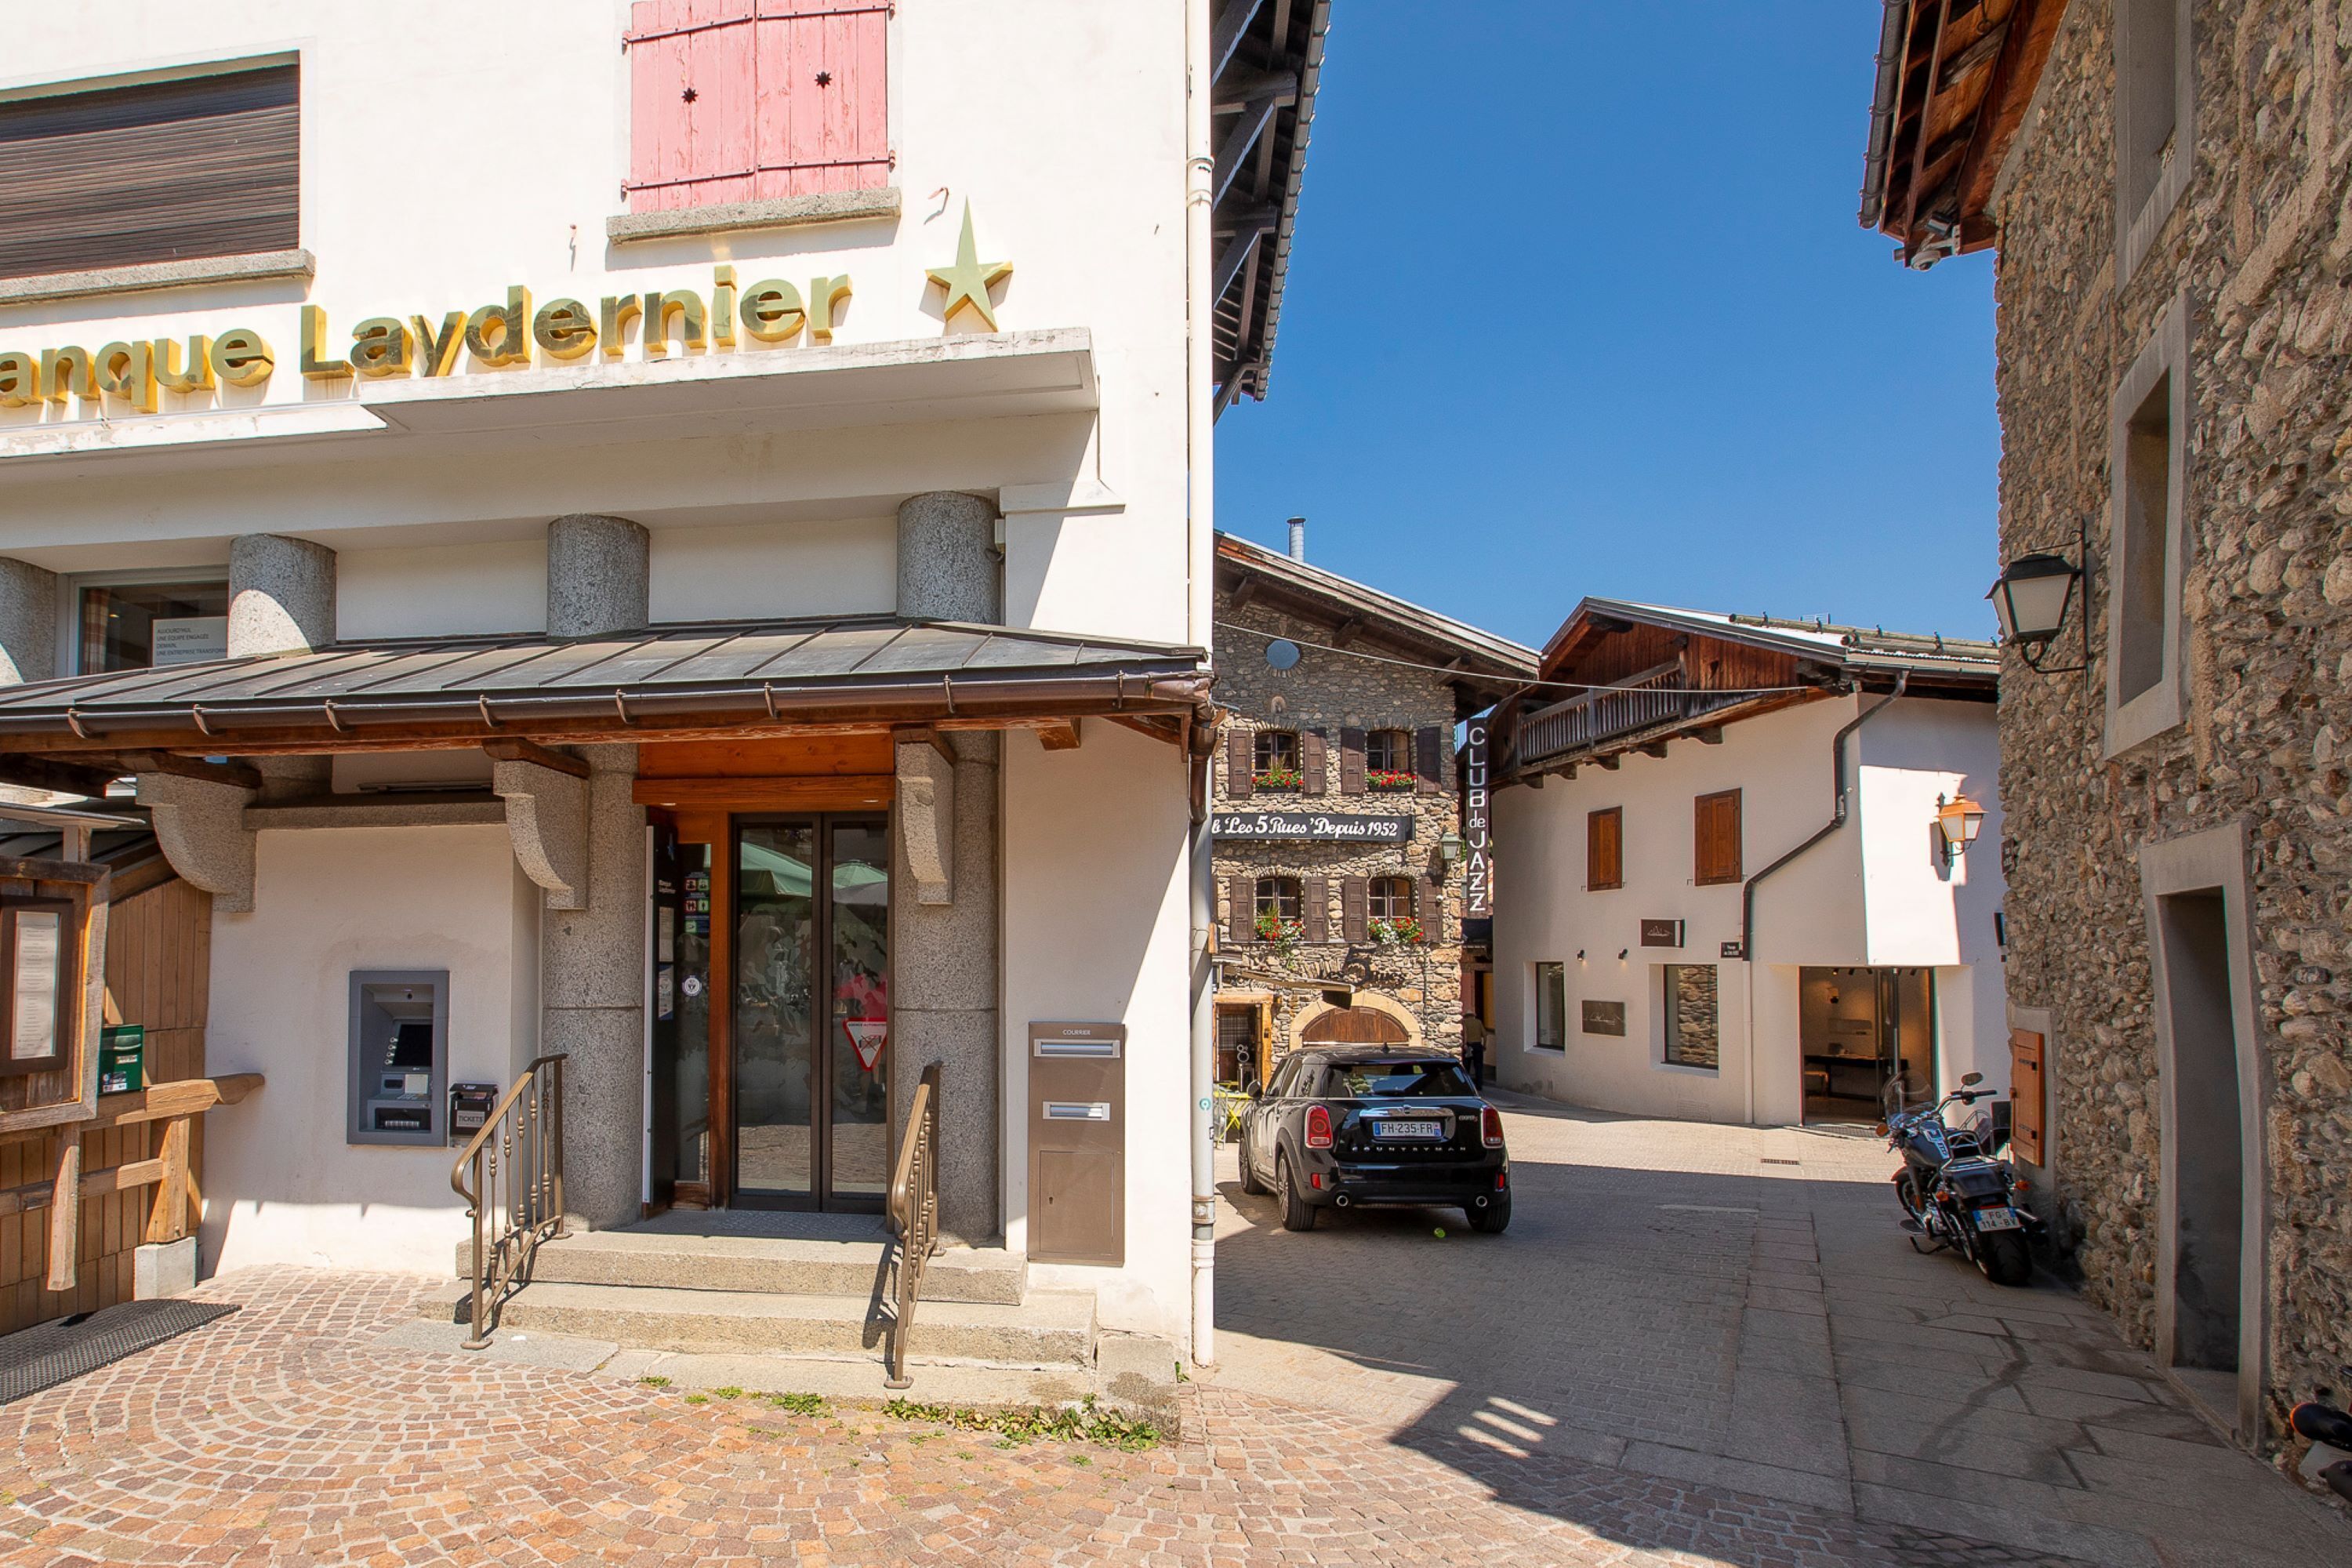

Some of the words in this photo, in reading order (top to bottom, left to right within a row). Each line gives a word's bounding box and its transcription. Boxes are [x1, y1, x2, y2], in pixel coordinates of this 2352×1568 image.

[0, 328, 274, 413] anque
[301, 264, 853, 380] Laydernier
[1469, 726, 1486, 808] CLUB
[1255, 815, 1269, 834] 5
[1269, 817, 1307, 833] Rues
[1367, 822, 1398, 837] 1952
[1468, 810, 1486, 828] de
[1468, 831, 1486, 911] JAZZ
